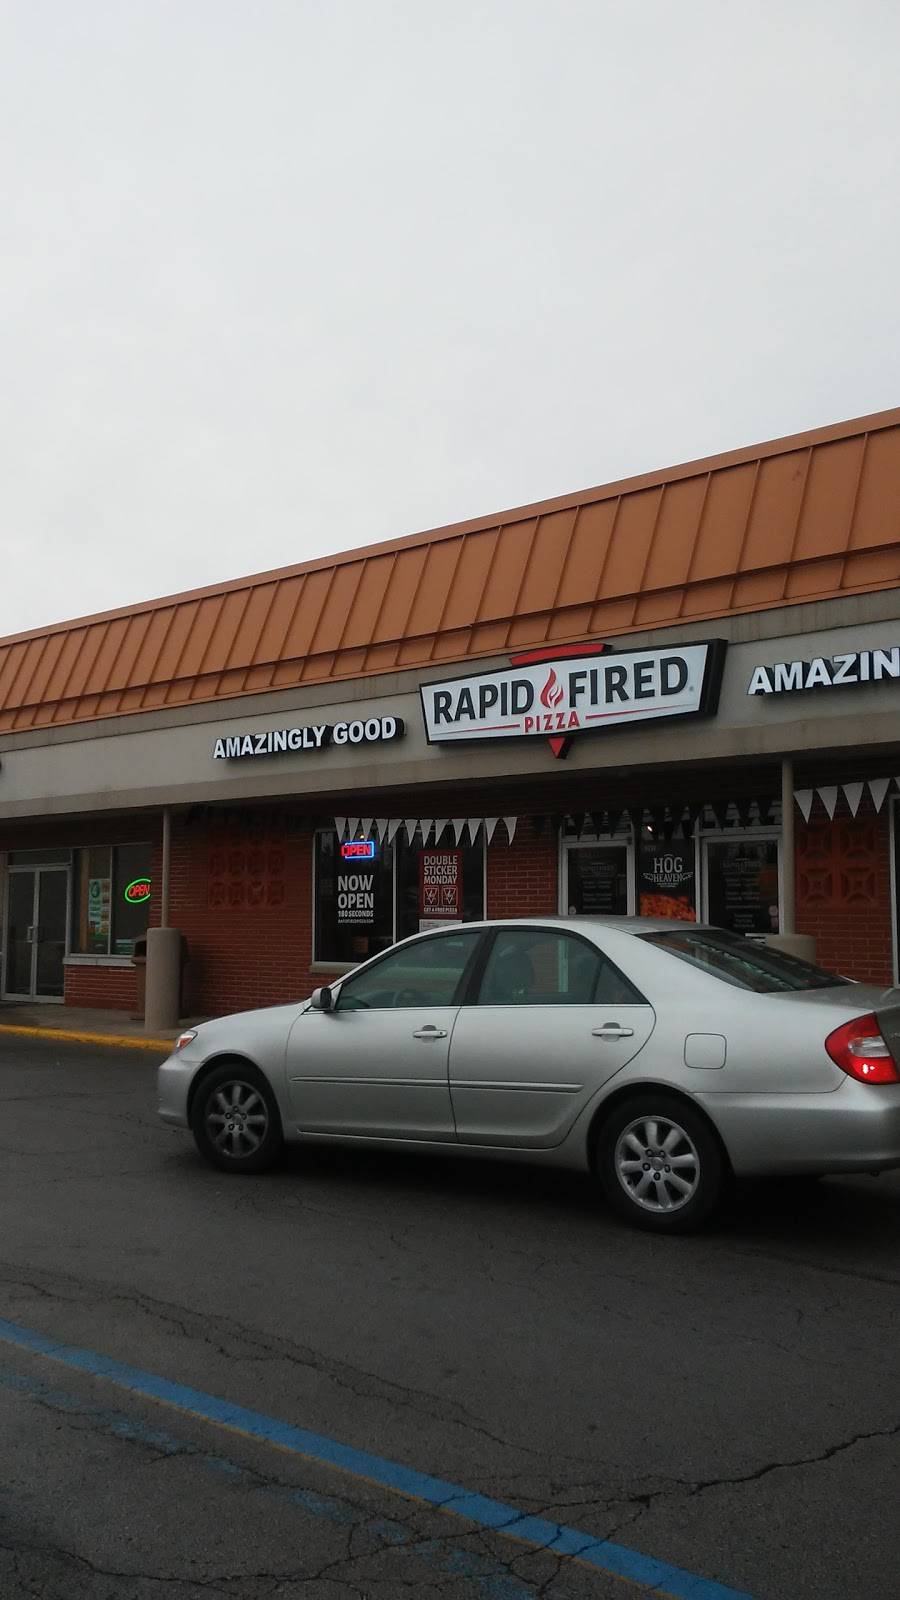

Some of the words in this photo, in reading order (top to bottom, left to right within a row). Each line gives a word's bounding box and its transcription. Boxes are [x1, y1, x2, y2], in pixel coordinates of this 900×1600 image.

[747, 647, 900, 695] AMAZIN
[433, 679, 534, 724] RAPID
[569, 655, 689, 708] FIRED
[524, 710, 581, 733] PIZZA
[213, 725, 326, 759] AMAZINGLY
[333, 716, 397, 745] GOOD
[341, 844, 371, 857] OPEN
[423, 855, 458, 865] DOUBLE
[653, 856, 683, 873] HOG
[423, 865, 458, 876] STICKER
[653, 873, 683, 883] HEAVEN
[337, 874, 374, 892] NOW
[423, 875, 458, 885] MONDAY
[128, 884, 150, 897] OPEN
[338, 892, 374, 909] OPEN
[338, 910, 348, 918] 180
[348, 910, 374, 918] SECONDS
